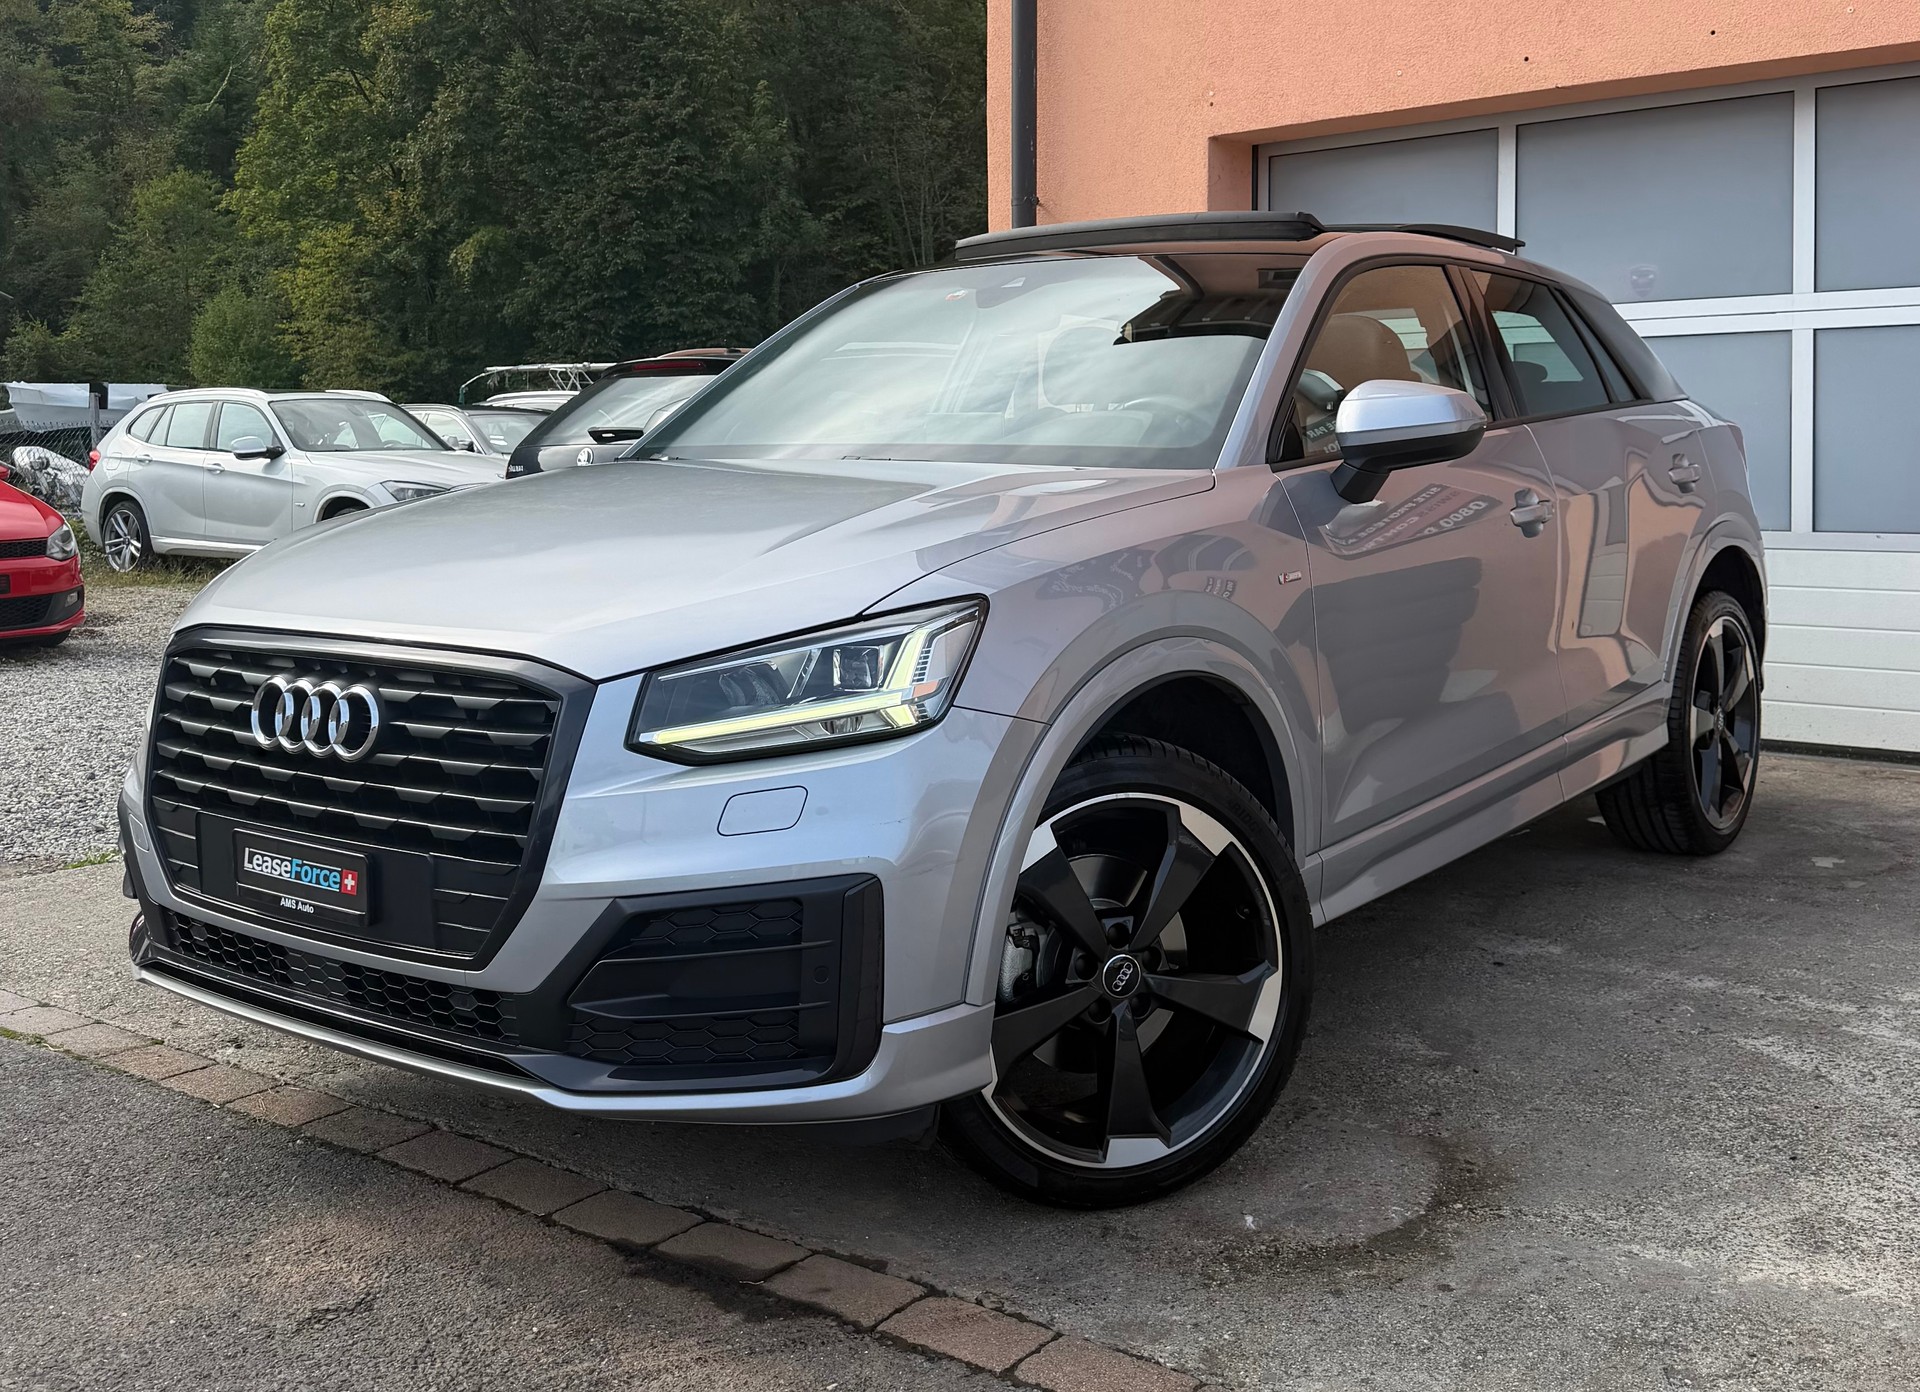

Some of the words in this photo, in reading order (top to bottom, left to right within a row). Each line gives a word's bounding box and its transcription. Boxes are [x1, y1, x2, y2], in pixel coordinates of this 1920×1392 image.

[243, 847, 342, 889] LeaseForce
[280, 897, 297, 909] AMS
[297, 902, 314, 914] Auto
